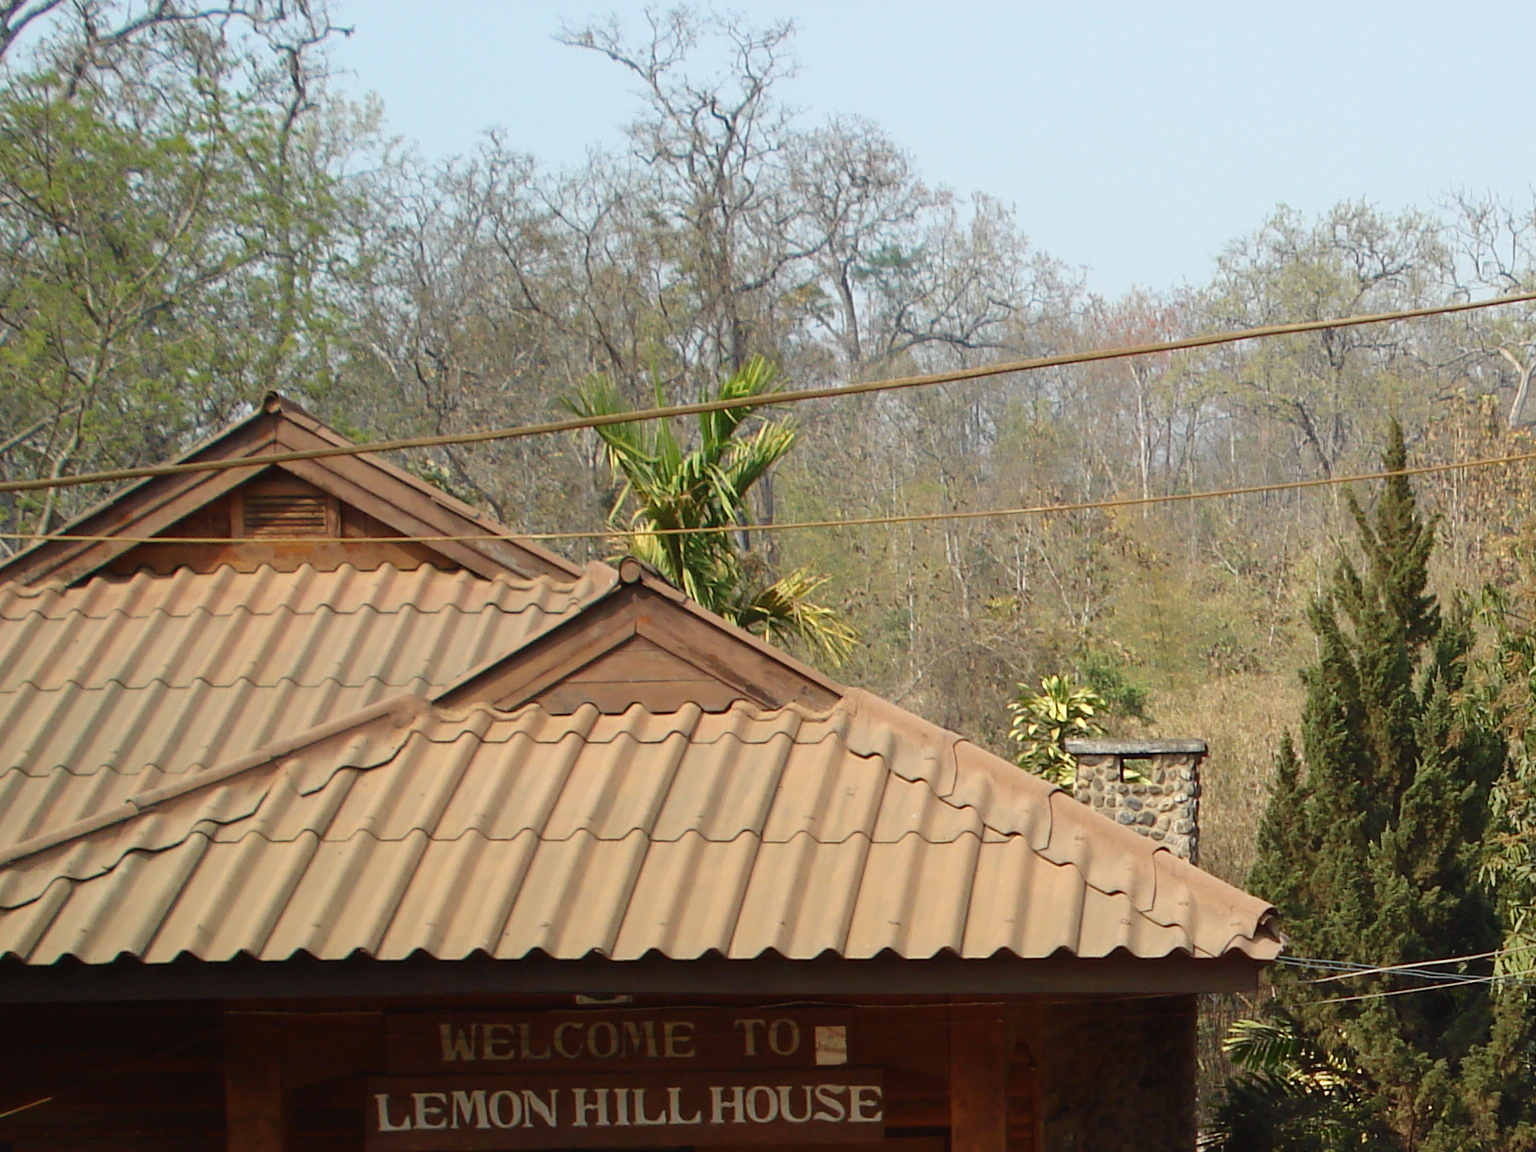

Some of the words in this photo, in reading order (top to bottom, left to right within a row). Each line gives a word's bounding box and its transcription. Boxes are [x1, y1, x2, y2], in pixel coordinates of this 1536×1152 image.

[439, 1020, 696, 1062] WELCOME
[734, 1018, 801, 1057] TO
[374, 1088, 560, 1132] LEMON
[571, 1085, 702, 1128] HILL
[709, 1083, 884, 1125] HOUSE
